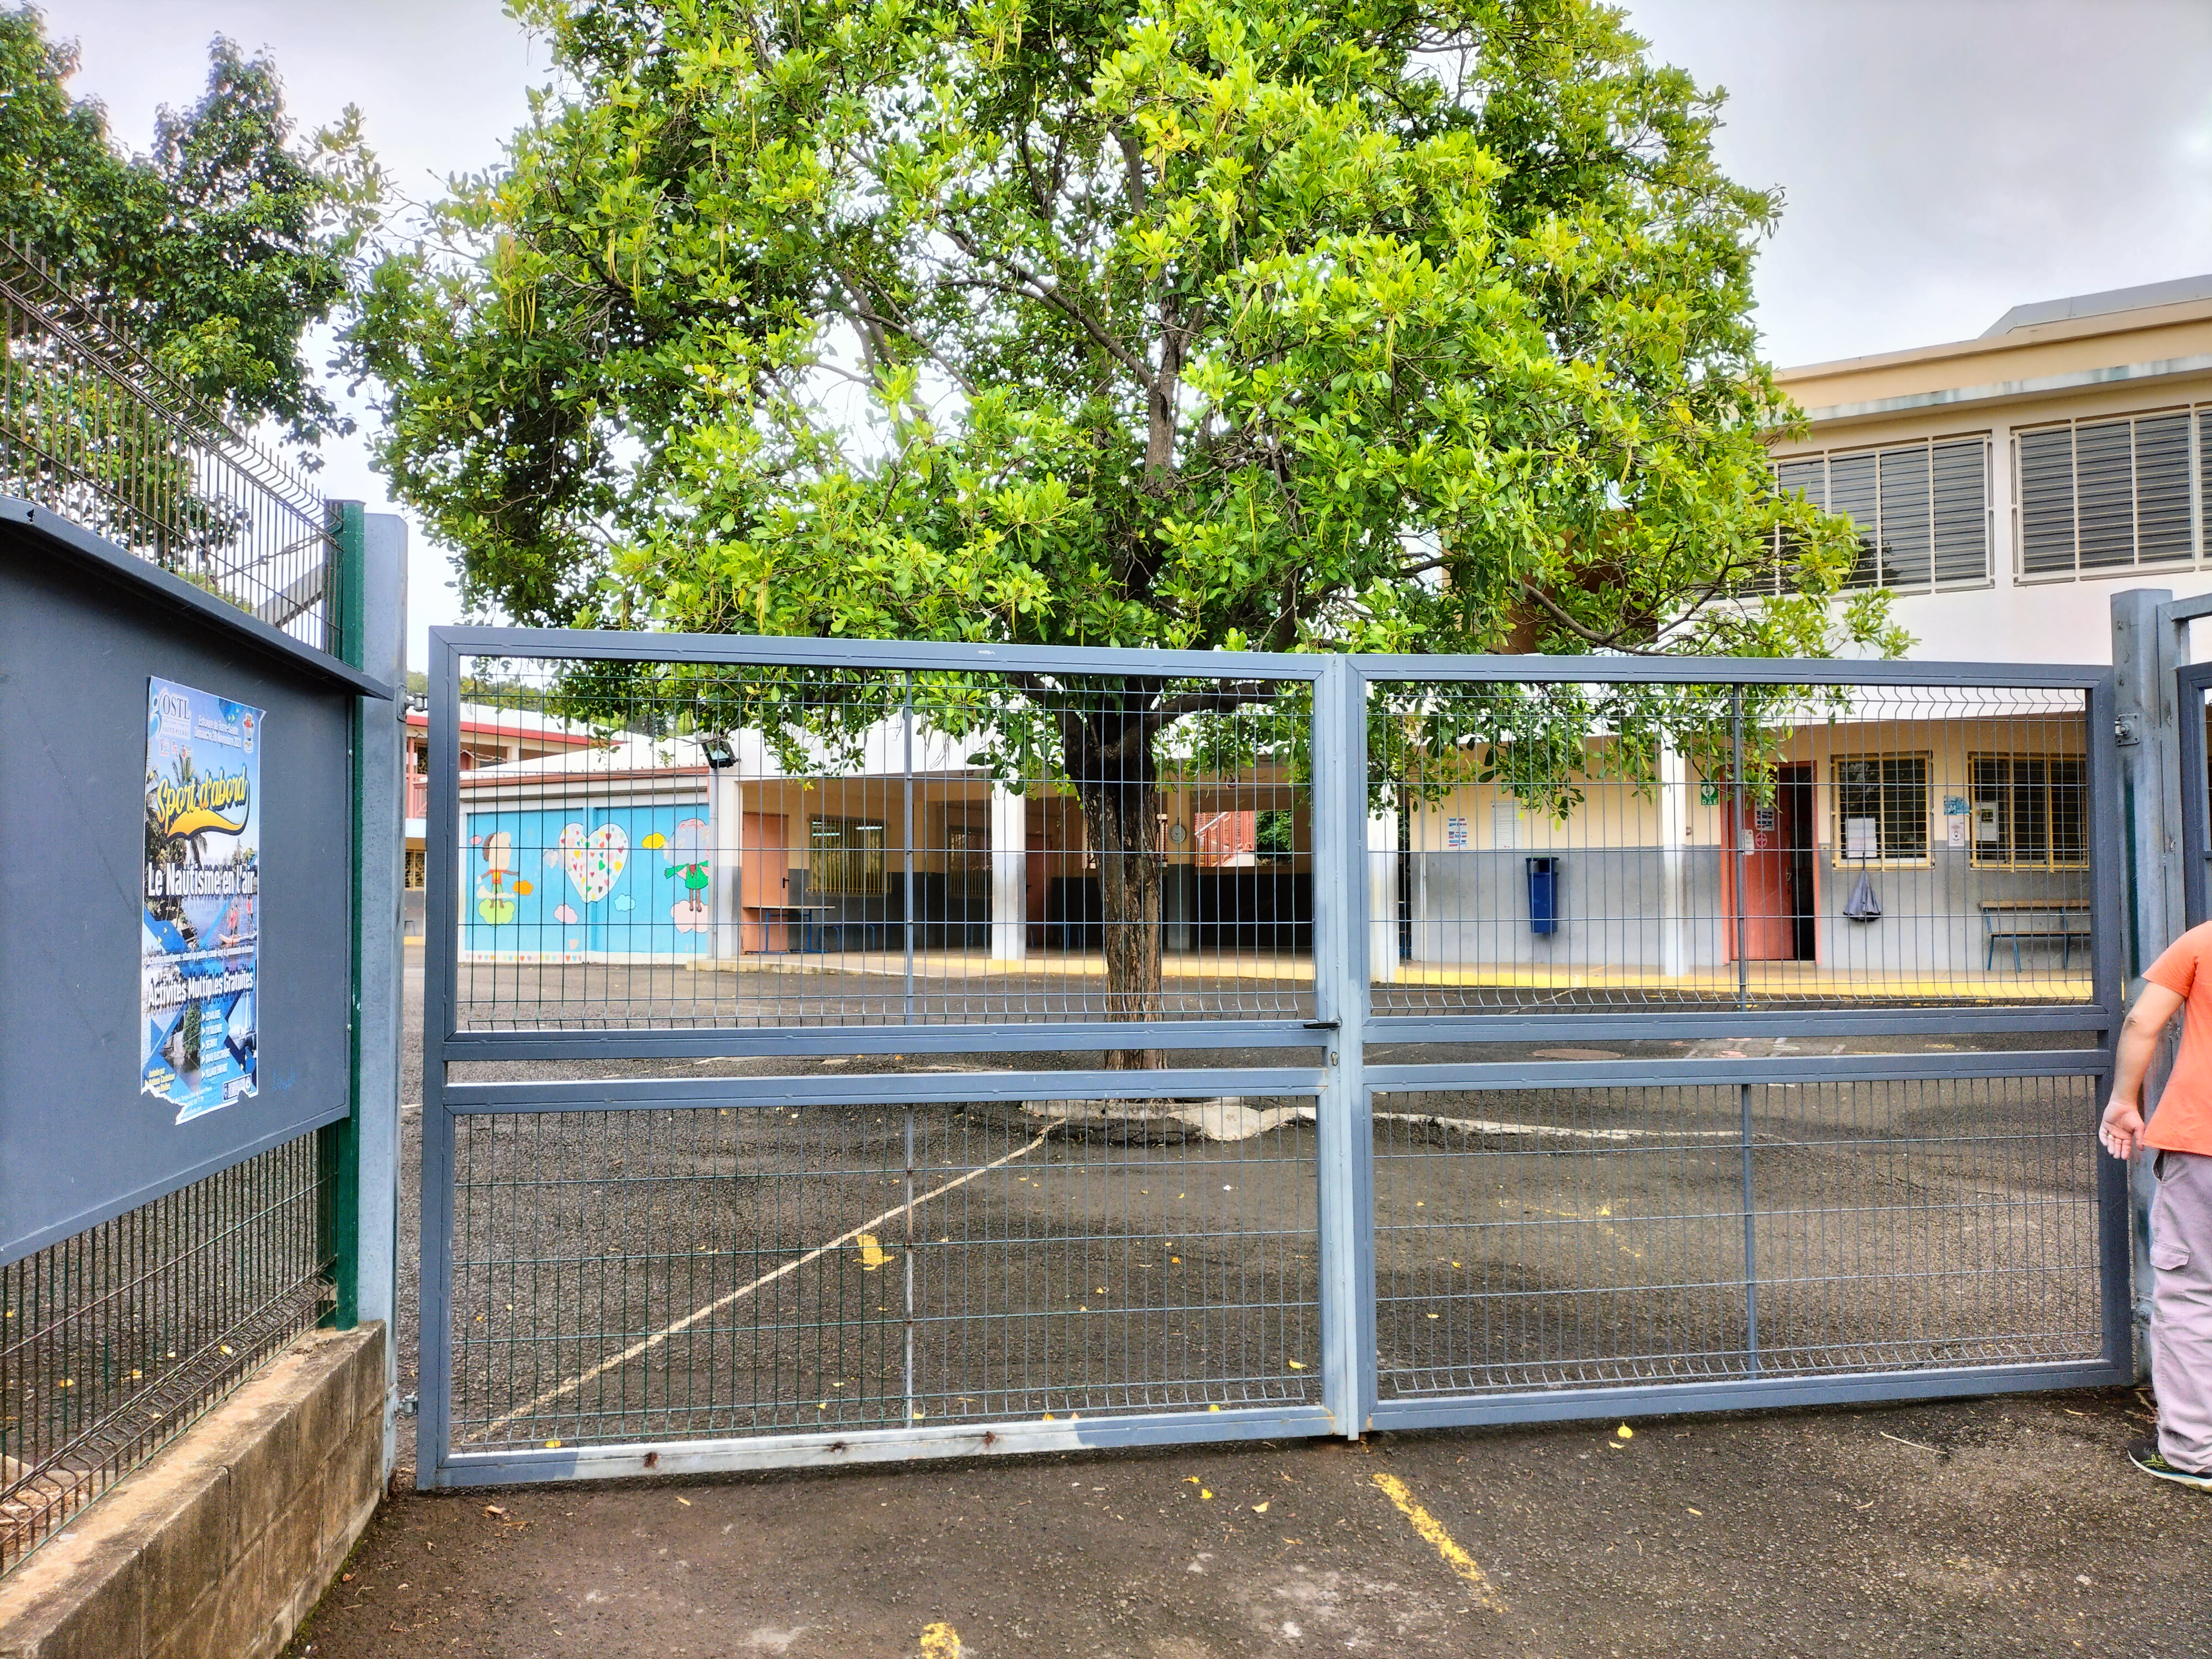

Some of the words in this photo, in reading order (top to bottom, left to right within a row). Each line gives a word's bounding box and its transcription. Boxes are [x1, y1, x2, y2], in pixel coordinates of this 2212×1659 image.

[163, 695, 190, 719] OSTL
[162, 726, 190, 737] SAINT-PIERRE
[157, 778, 196, 834] Sport
[199, 765, 248, 810] d'abord
[148, 862, 163, 896] Le
[166, 862, 221, 896] Nautisme
[222, 870, 234, 895] en
[236, 864, 255, 894] l'air
[148, 978, 186, 1007] Activités
[188, 973, 223, 1000] Multiples
[224, 968, 253, 993] Gratuites
